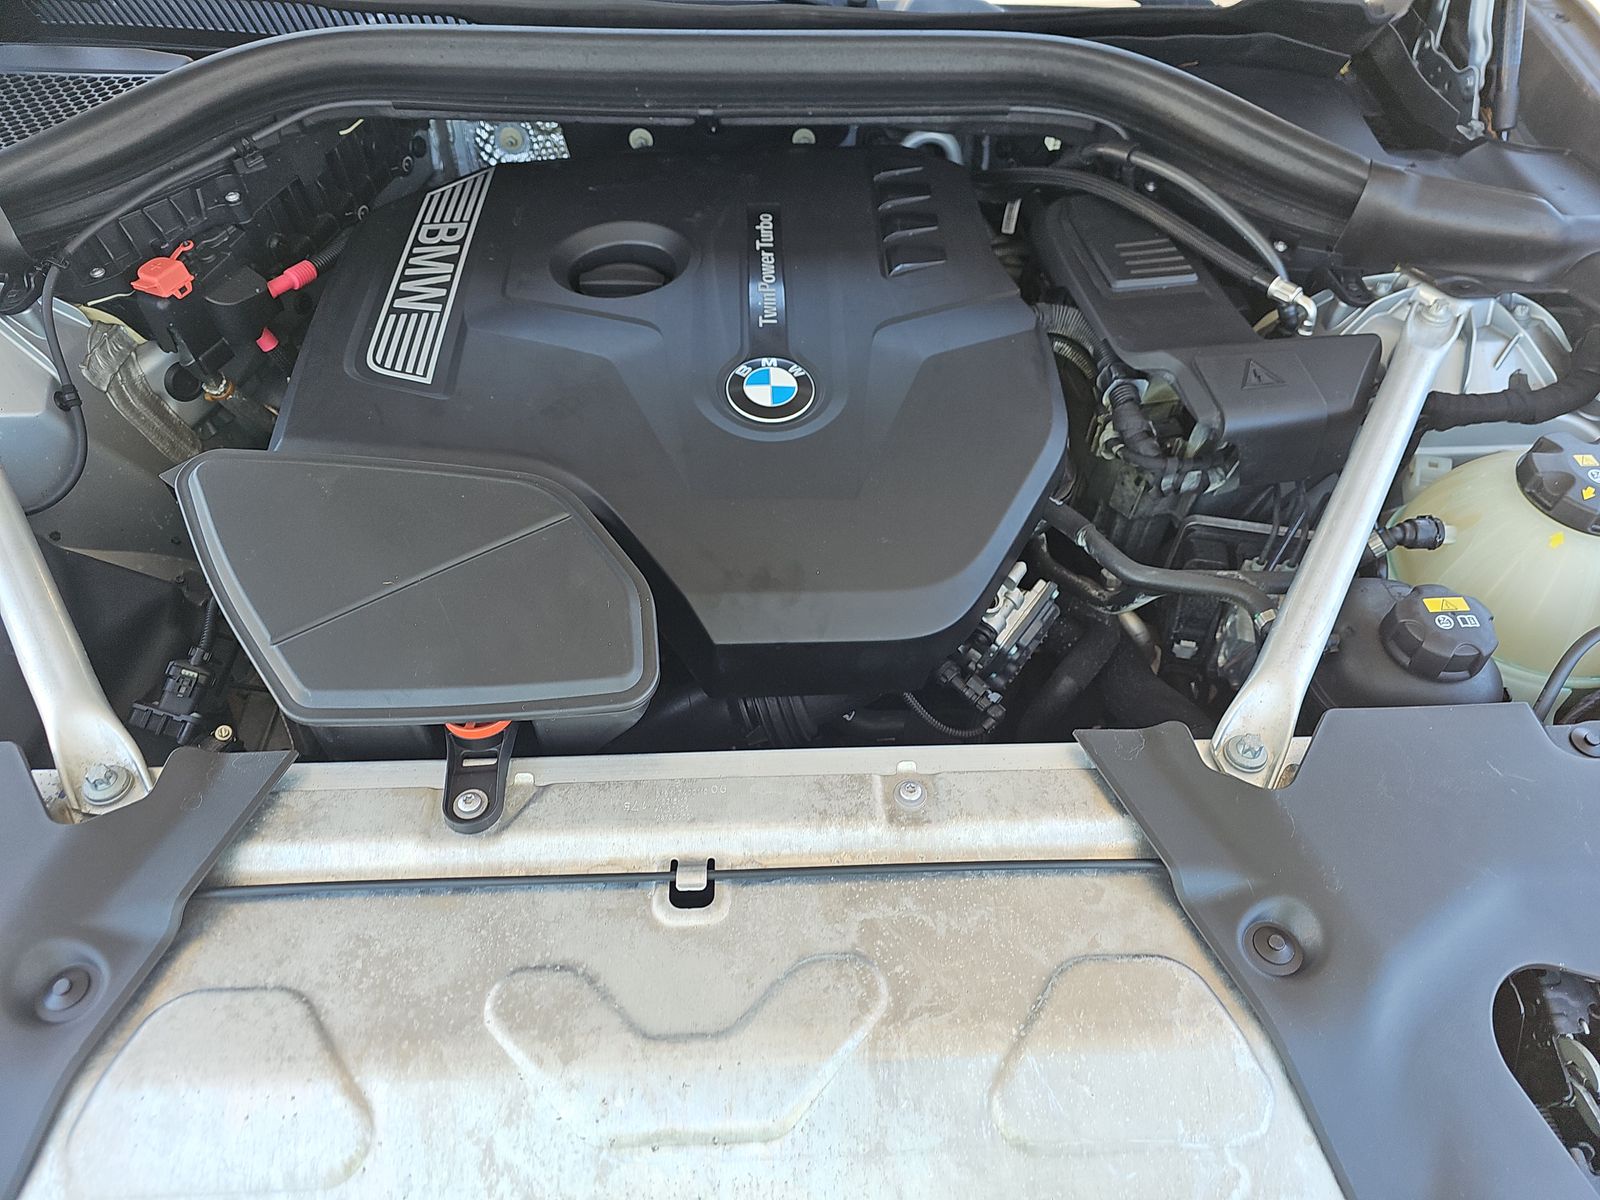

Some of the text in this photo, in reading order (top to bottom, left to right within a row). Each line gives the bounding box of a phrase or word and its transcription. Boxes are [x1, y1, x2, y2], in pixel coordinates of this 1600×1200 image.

[393, 222, 469, 312] BMW
[755, 213, 778, 327] TwinPower Turbo
[734, 357, 805, 378] BMW
